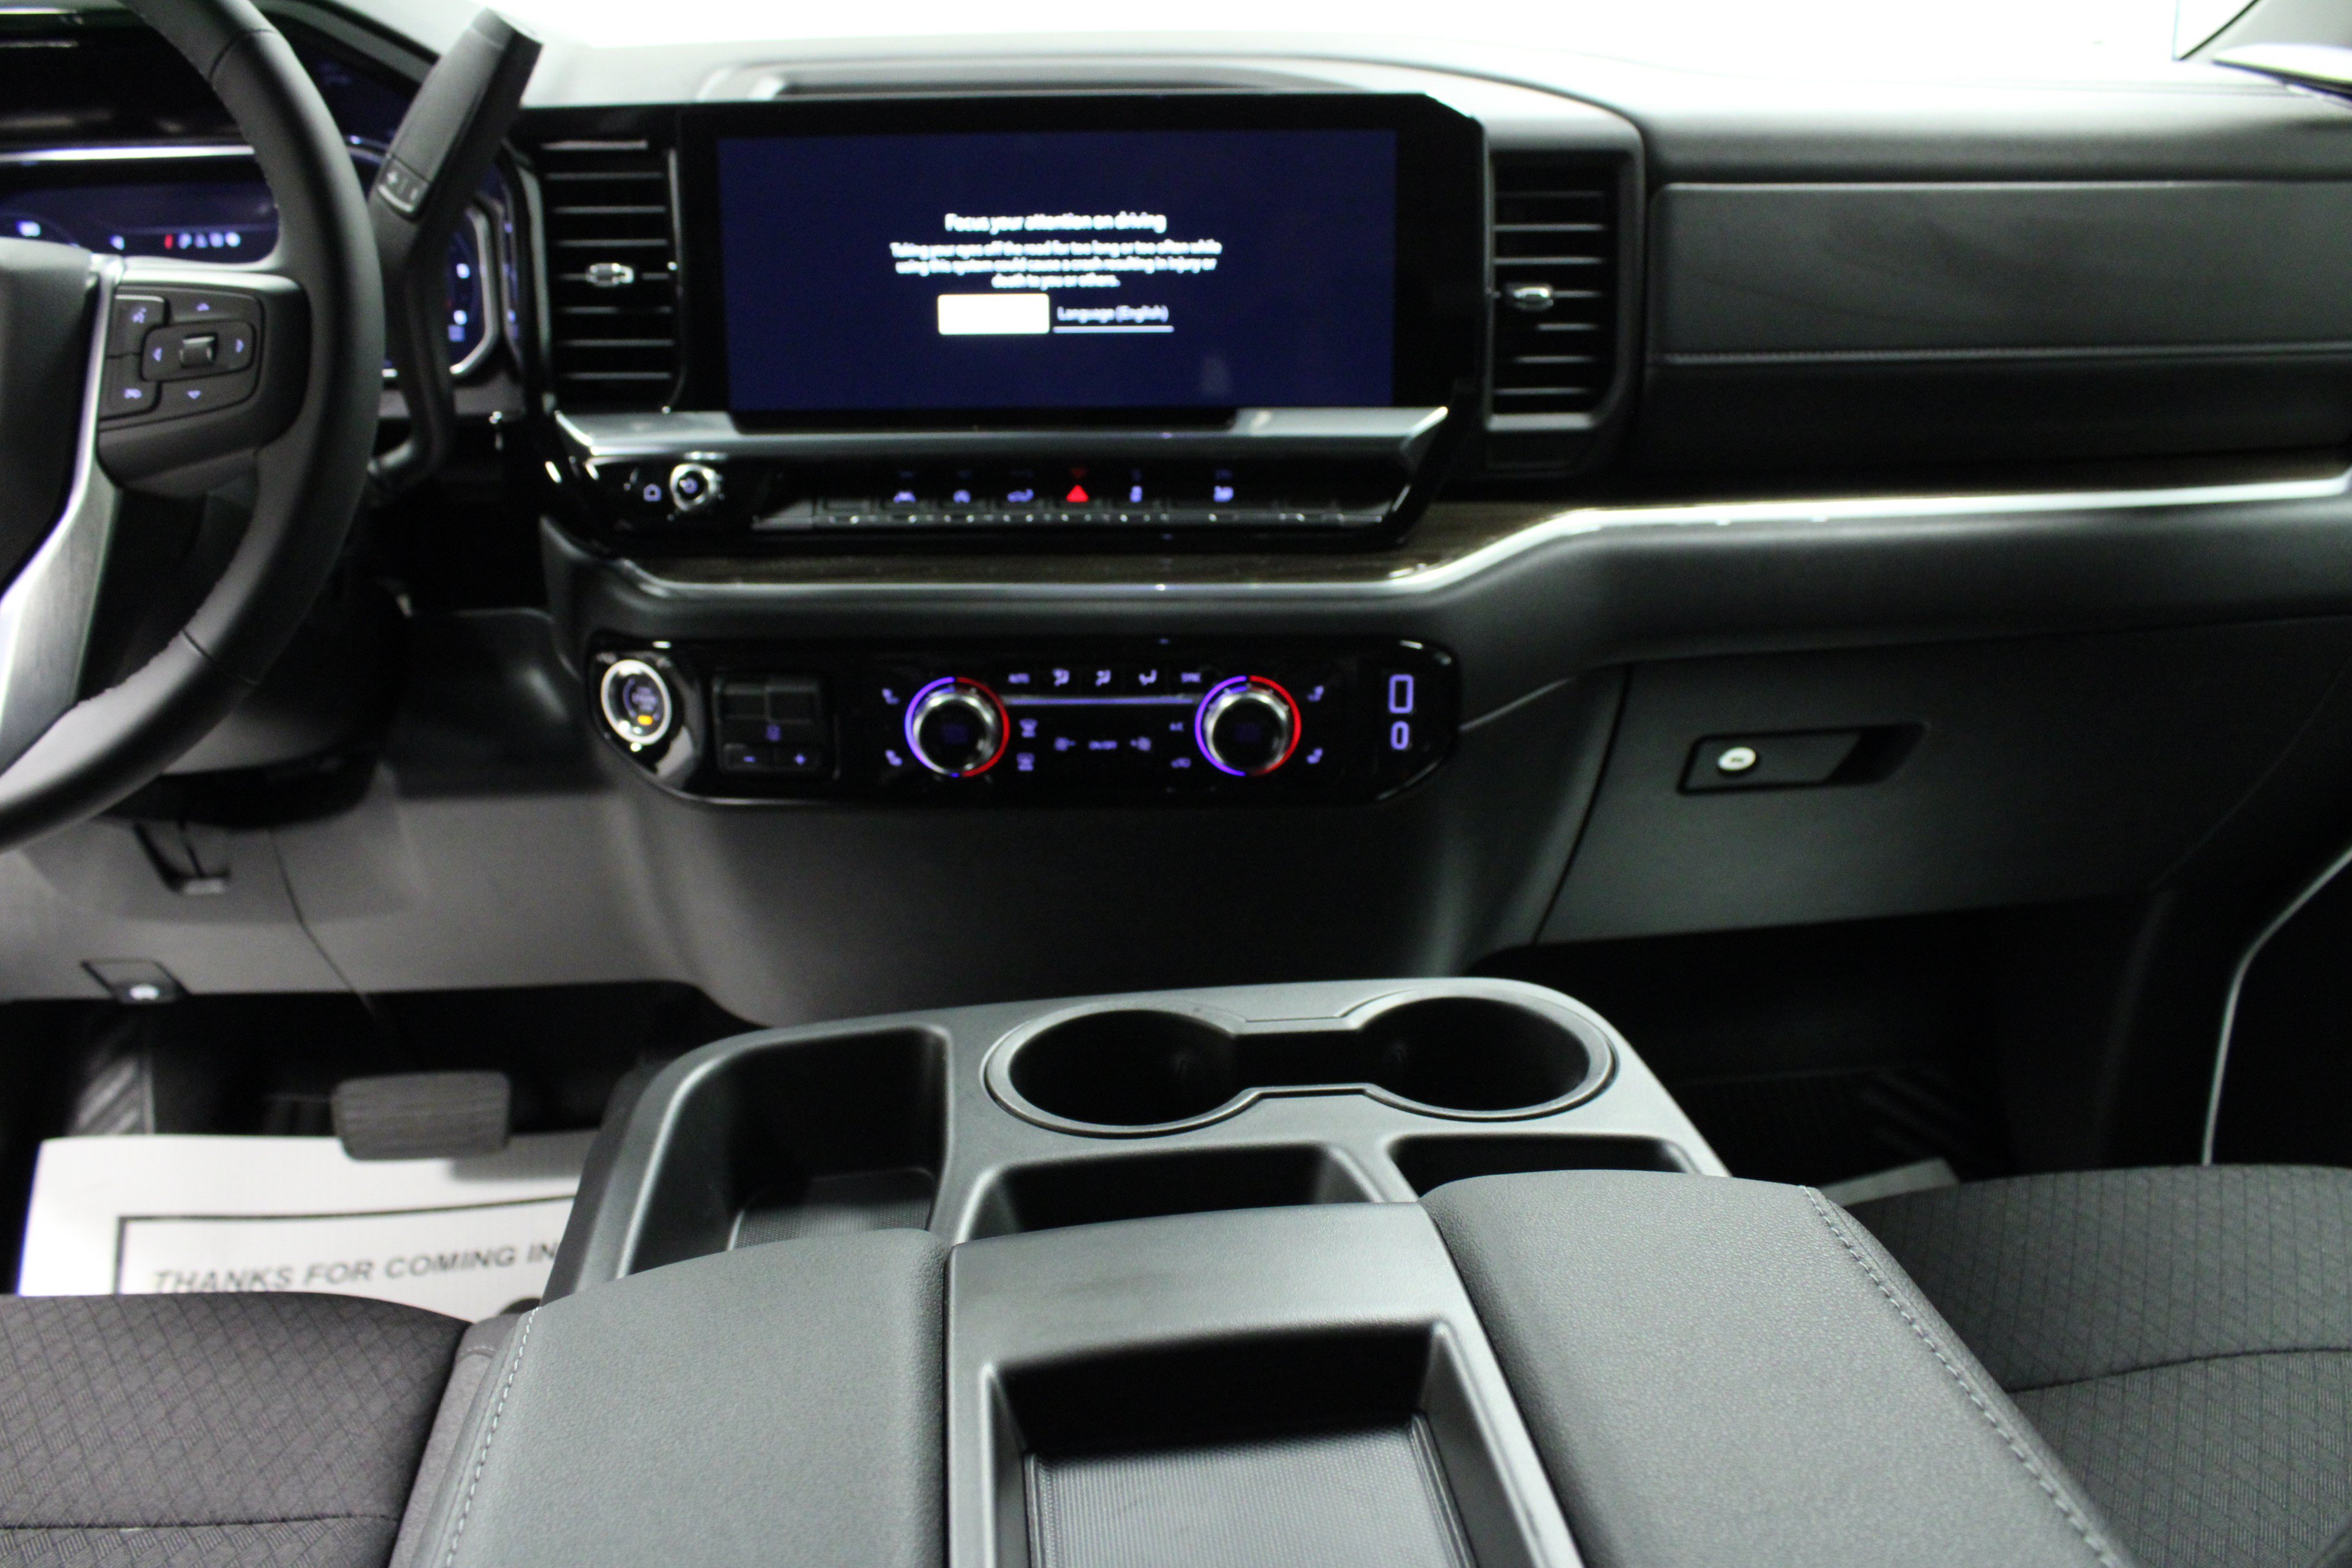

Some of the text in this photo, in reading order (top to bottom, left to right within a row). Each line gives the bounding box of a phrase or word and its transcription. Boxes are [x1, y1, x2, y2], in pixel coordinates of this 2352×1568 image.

[155, 1239, 561, 1293] THANKS FOR COMING IN
